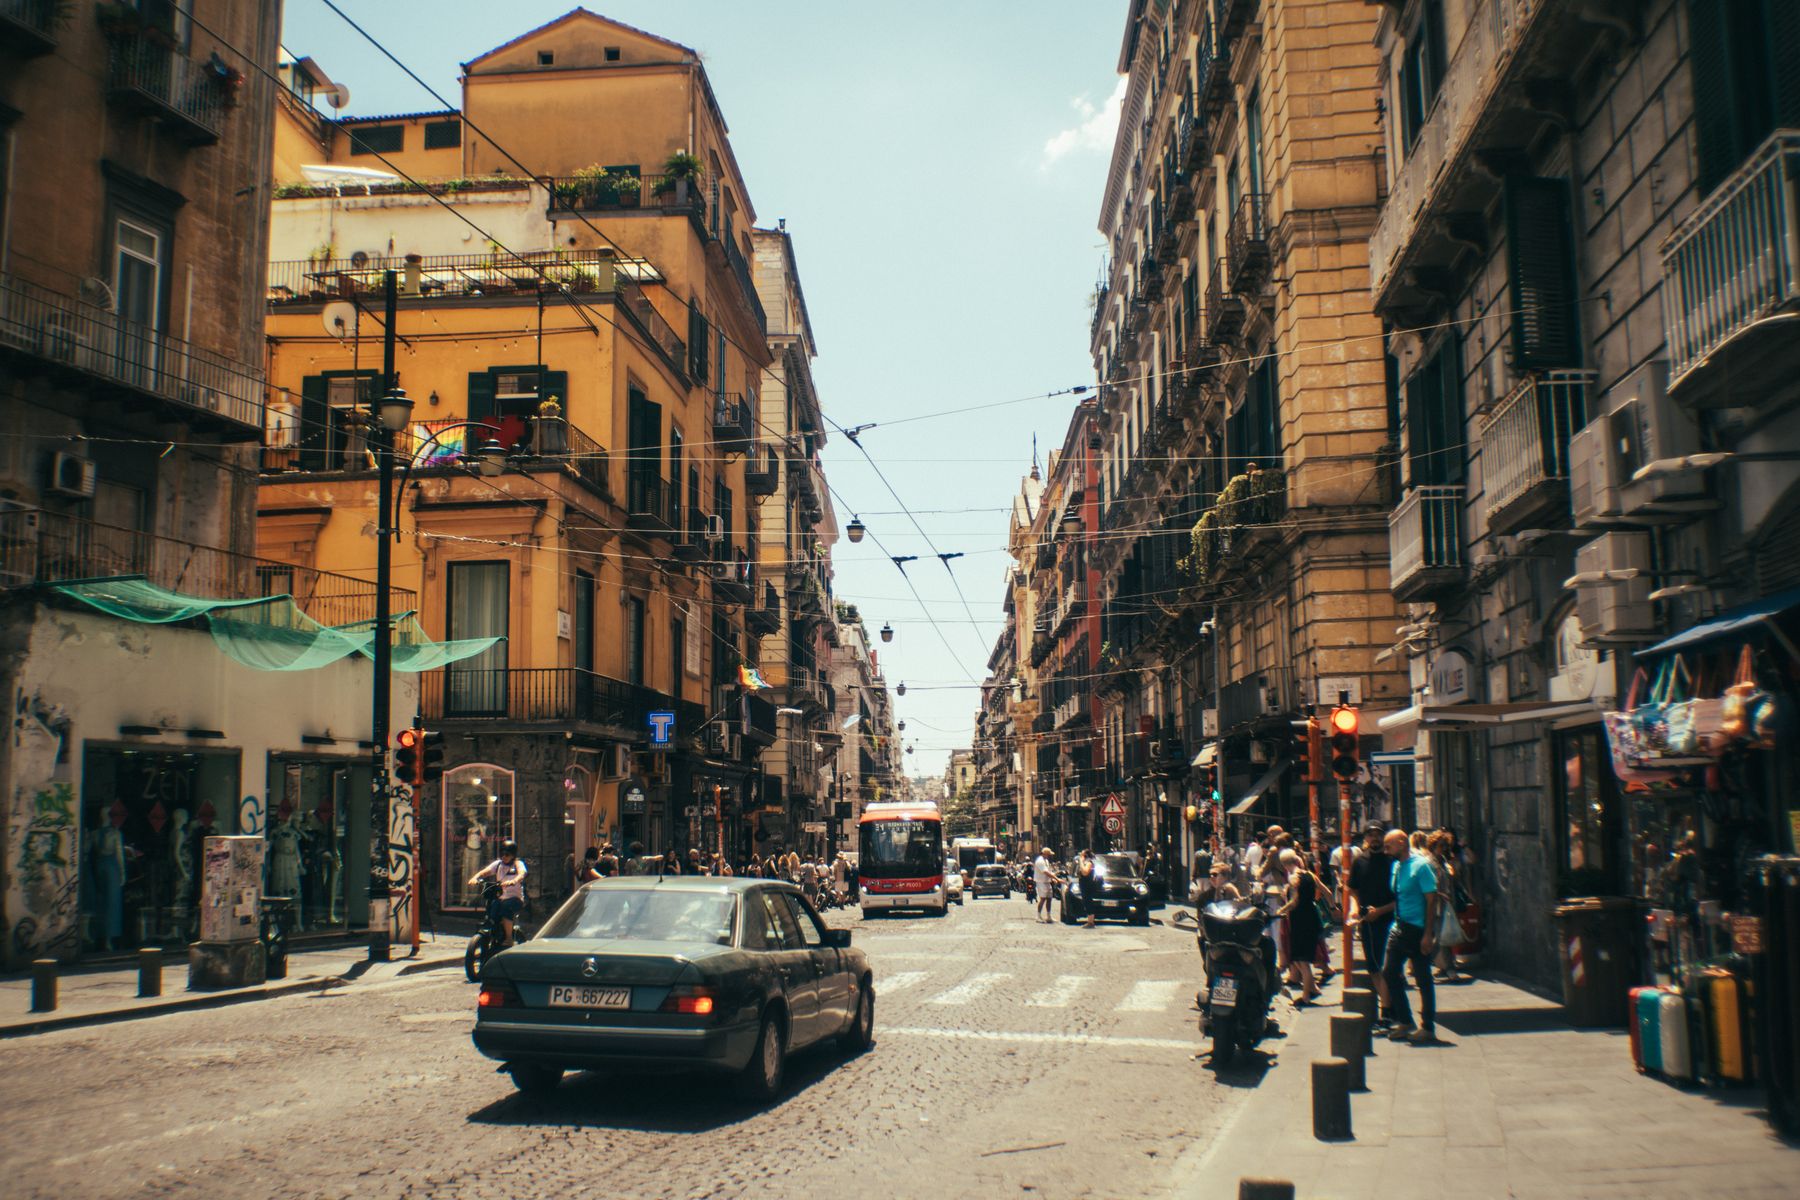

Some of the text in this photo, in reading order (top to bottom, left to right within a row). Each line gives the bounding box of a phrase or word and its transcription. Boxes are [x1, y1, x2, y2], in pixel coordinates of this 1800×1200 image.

[649, 713, 674, 742] T
[1107, 820, 1119, 830] 30
[553, 987, 629, 1006] PG 667227
